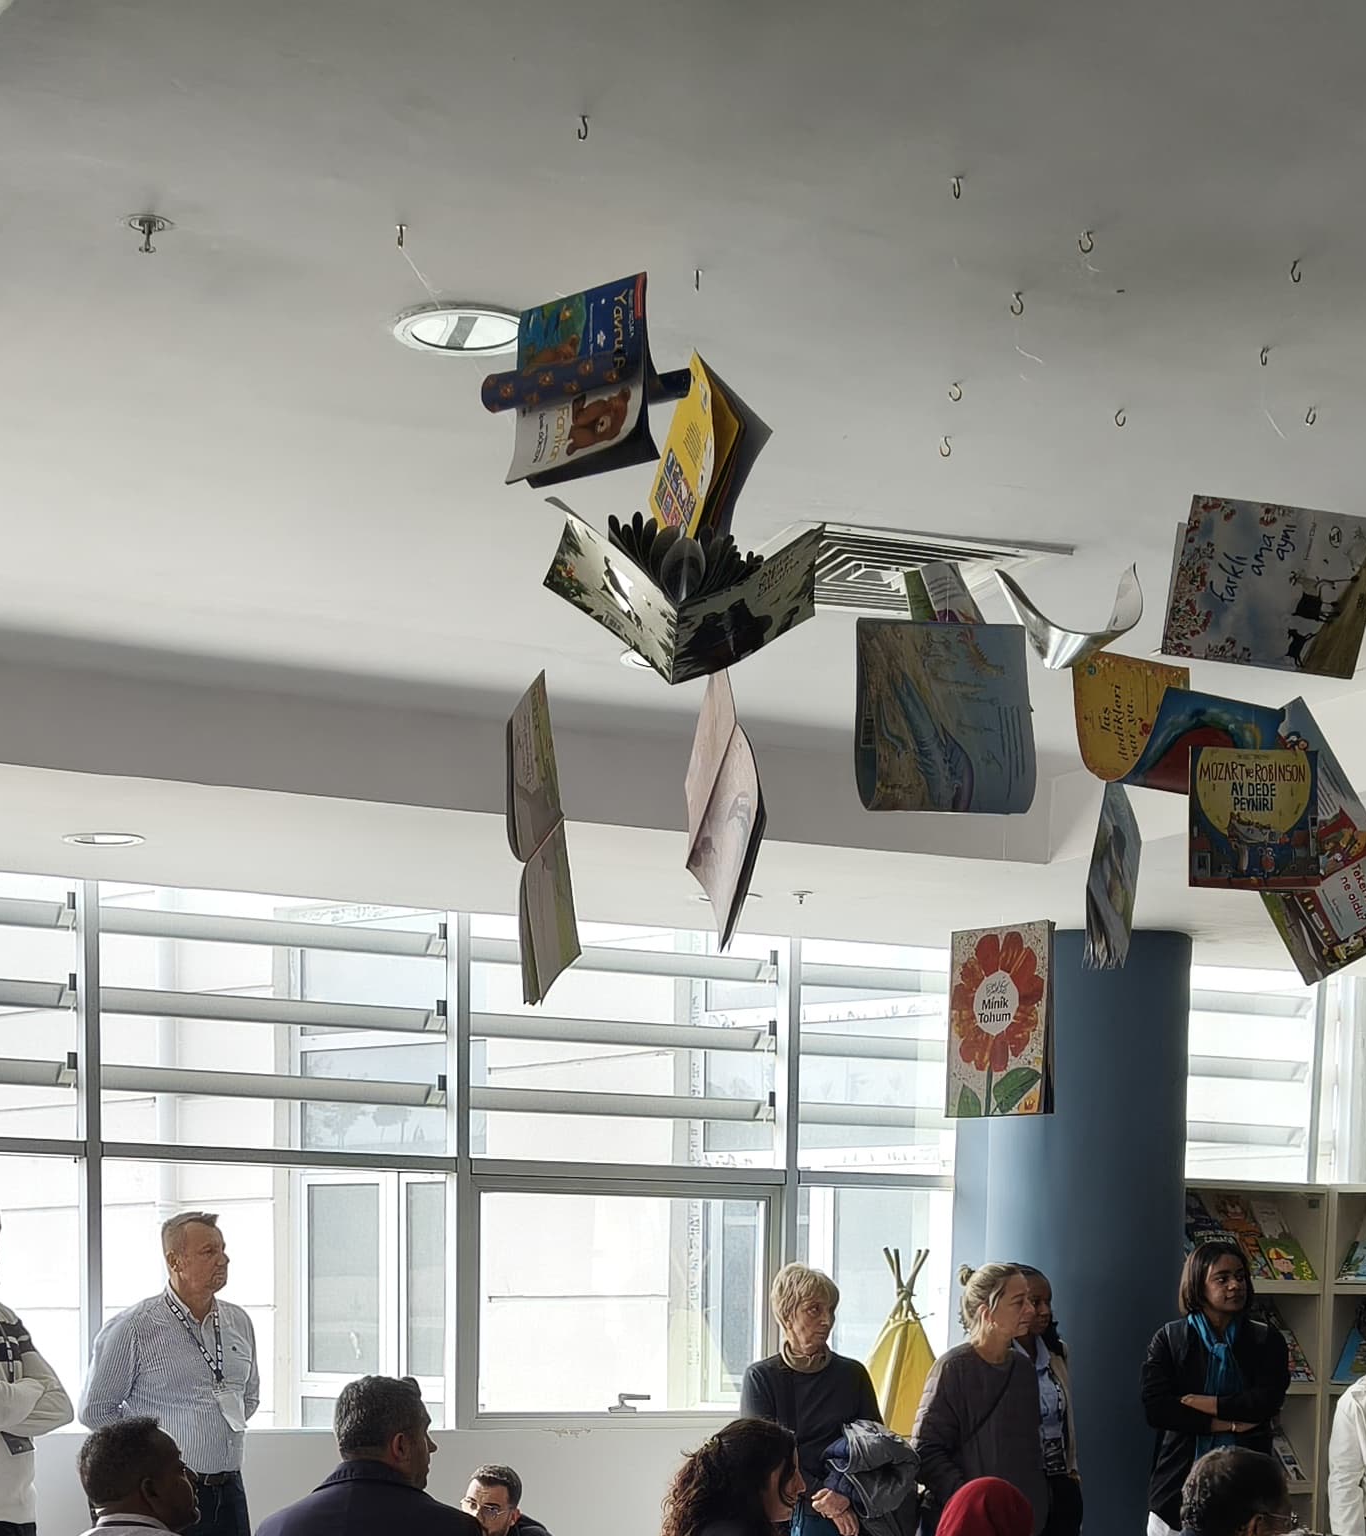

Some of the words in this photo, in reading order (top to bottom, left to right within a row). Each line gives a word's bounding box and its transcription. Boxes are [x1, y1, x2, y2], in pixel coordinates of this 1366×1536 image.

[1251, 534, 1275, 576] ama
[1199, 762, 1245, 782] MOZART
[1245, 768, 1254, 779] ve
[1231, 782, 1244, 797] AY
[1248, 783, 1276, 797] DEDE
[1340, 876, 1352, 893] ne
[981, 995, 1009, 1011] Minik
[978, 1011, 1012, 1024] Tohum
